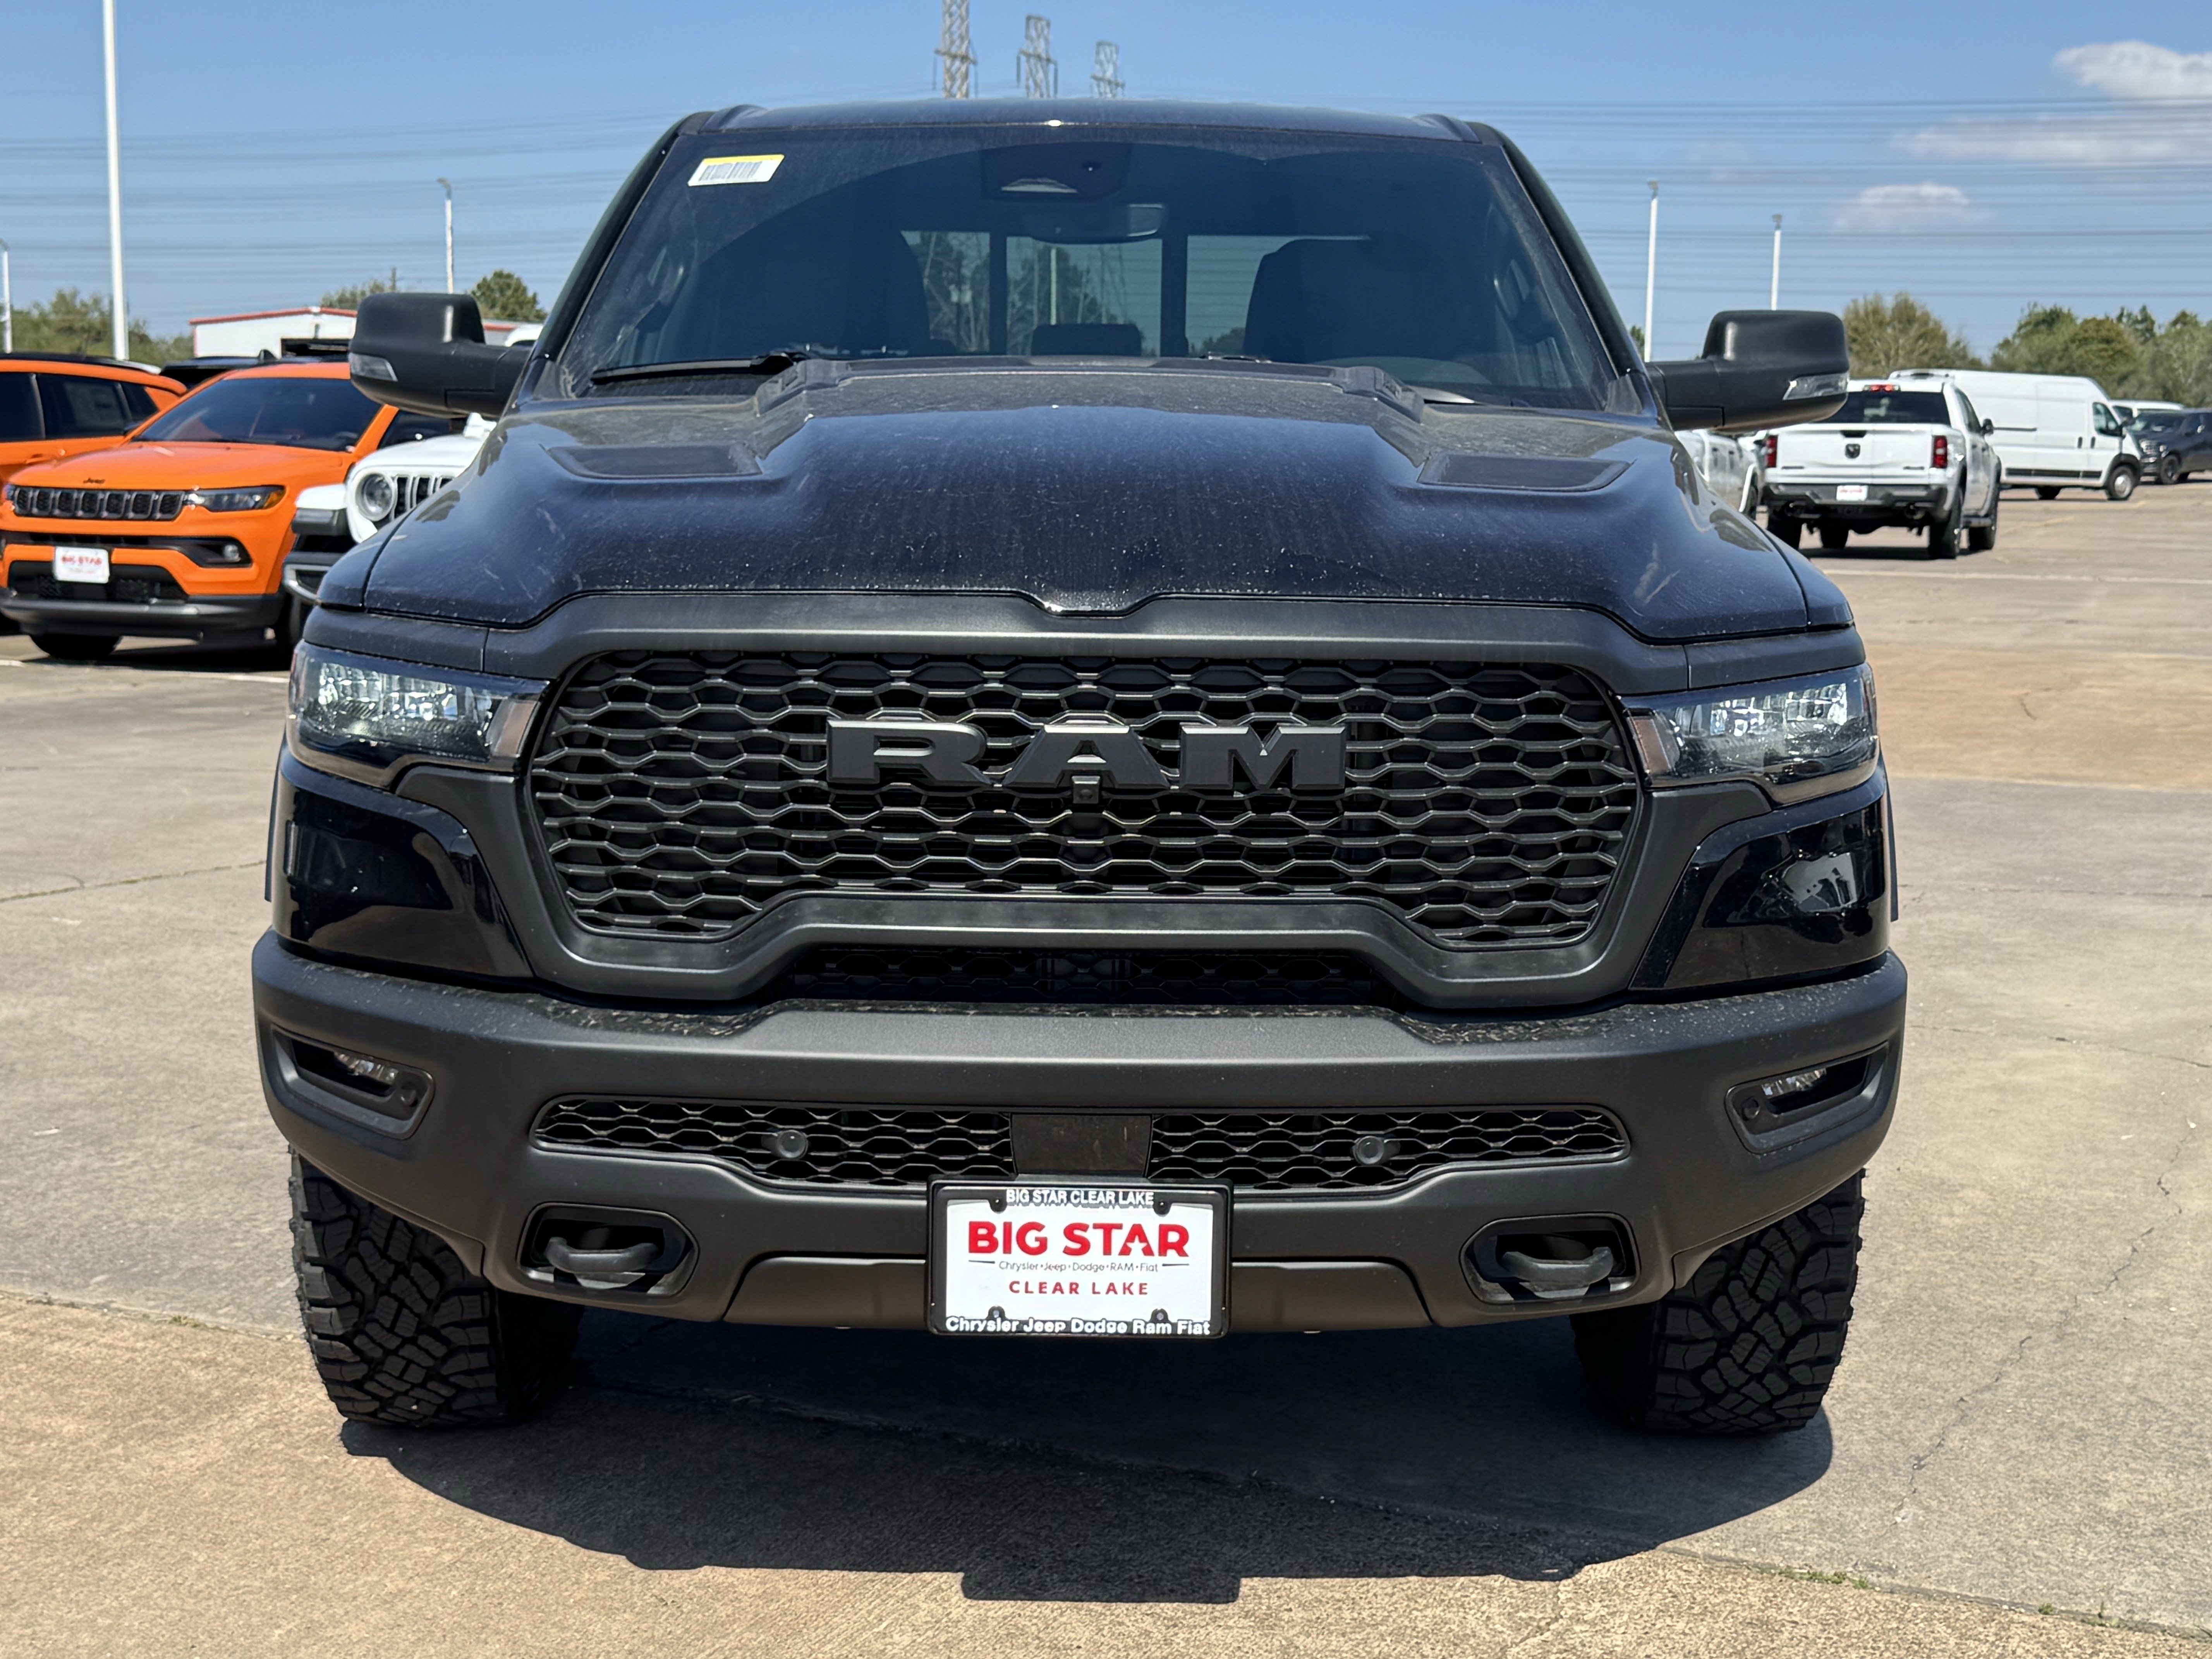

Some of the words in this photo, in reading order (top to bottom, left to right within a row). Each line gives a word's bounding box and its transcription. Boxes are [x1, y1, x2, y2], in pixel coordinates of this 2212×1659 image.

[826, 719, 1346, 790] RAM
[1006, 1189, 1029, 1203] BIG
[1033, 1190, 1067, 1203] STAR
[1070, 1191, 1115, 1204] CLEAR
[1119, 1192, 1154, 1205] LAKE
[969, 1221, 1048, 1256] BIG
[1063, 1223, 1190, 1257] STAR
[999, 1261, 1039, 1272] Chrysler
[1044, 1262, 1066, 1272] Jeep
[1072, 1262, 1105, 1273] Dodge
[1110, 1263, 1134, 1271] RAM
[1140, 1263, 1158, 1272] Fiat
[1009, 1281, 1080, 1295] CLEAR
[1092, 1282, 1148, 1295] LAKE
[946, 1317, 1019, 1332] Chrysler
[1023, 1318, 1066, 1333] Jeep
[1071, 1318, 1128, 1334] Dodge
[1132, 1319, 1172, 1334] Ram
[1177, 1320, 1210, 1335] Fiat
